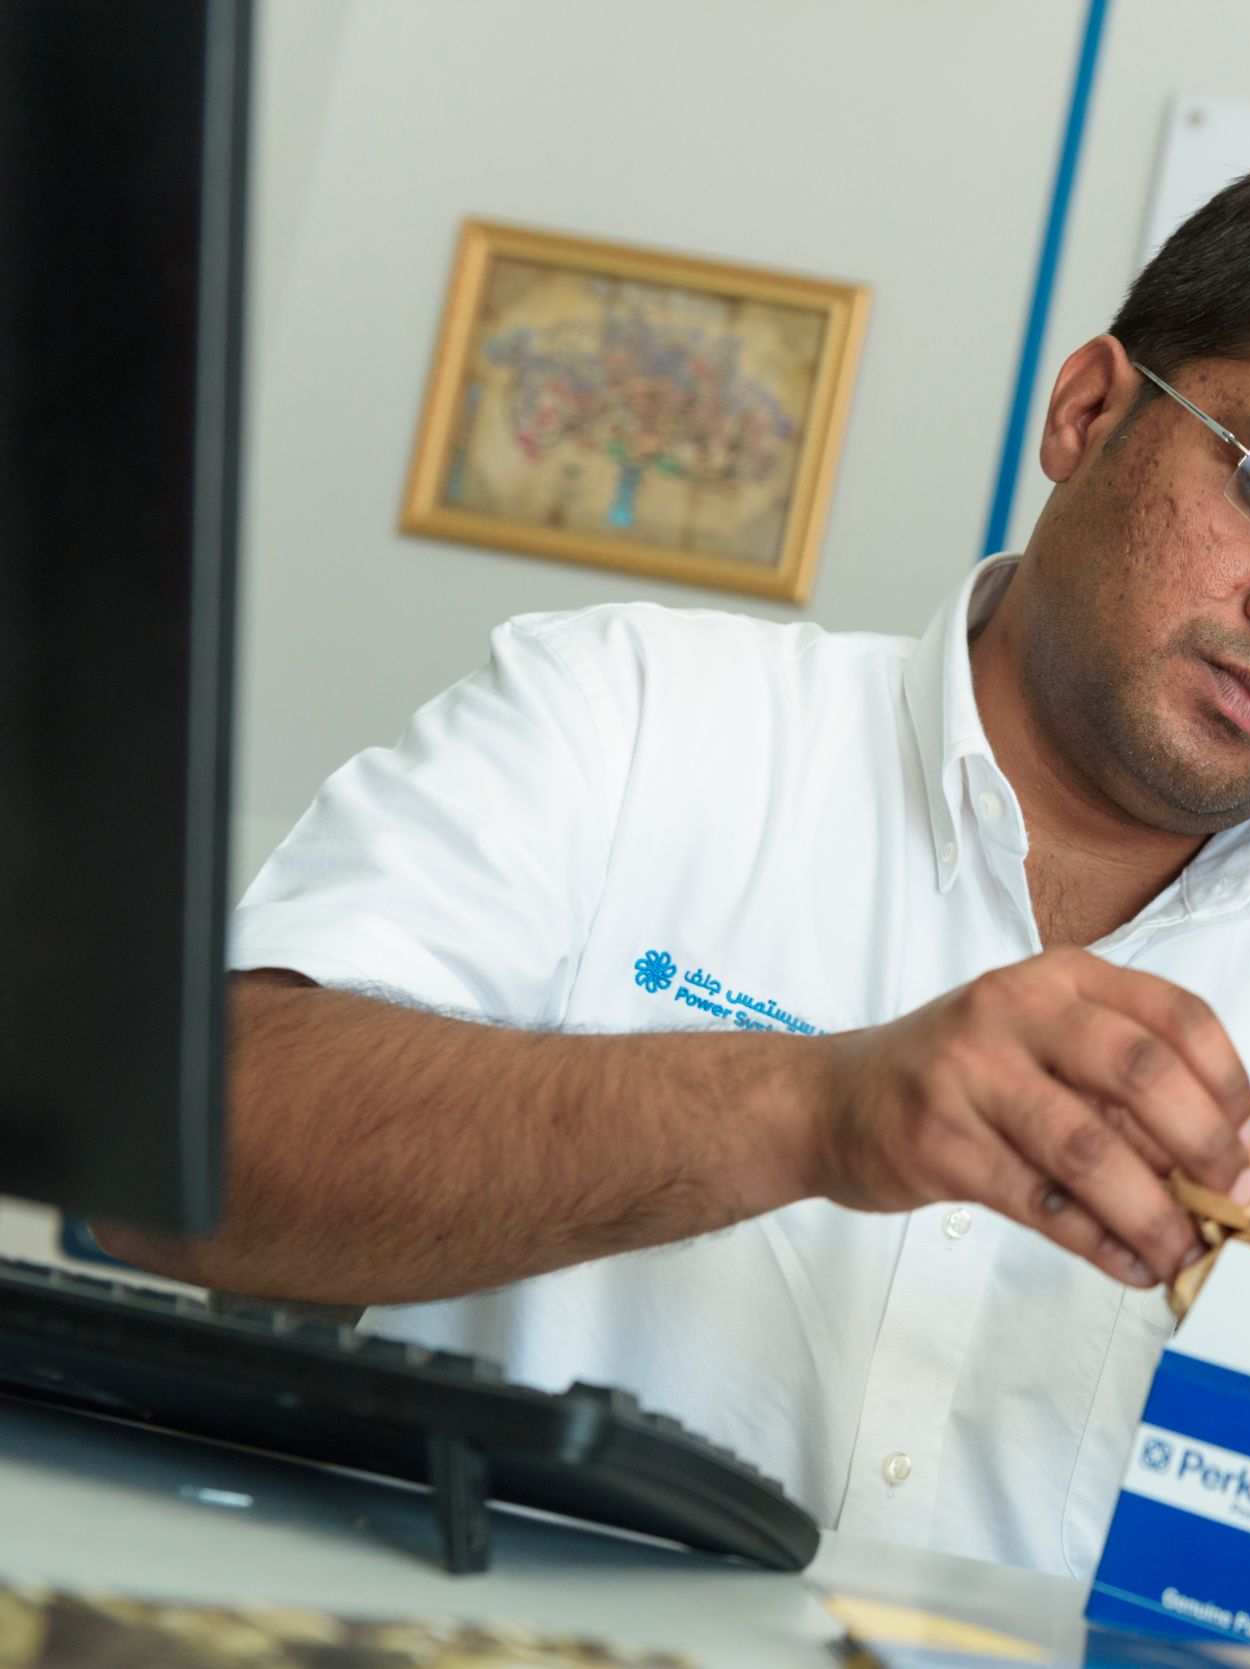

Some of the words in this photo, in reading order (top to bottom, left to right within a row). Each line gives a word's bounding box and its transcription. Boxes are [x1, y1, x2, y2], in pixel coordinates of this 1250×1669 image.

[685, 968, 722, 996] جلف
[674, 986, 734, 1020] Power
[1161, 1586, 1233, 1630] Genuine
